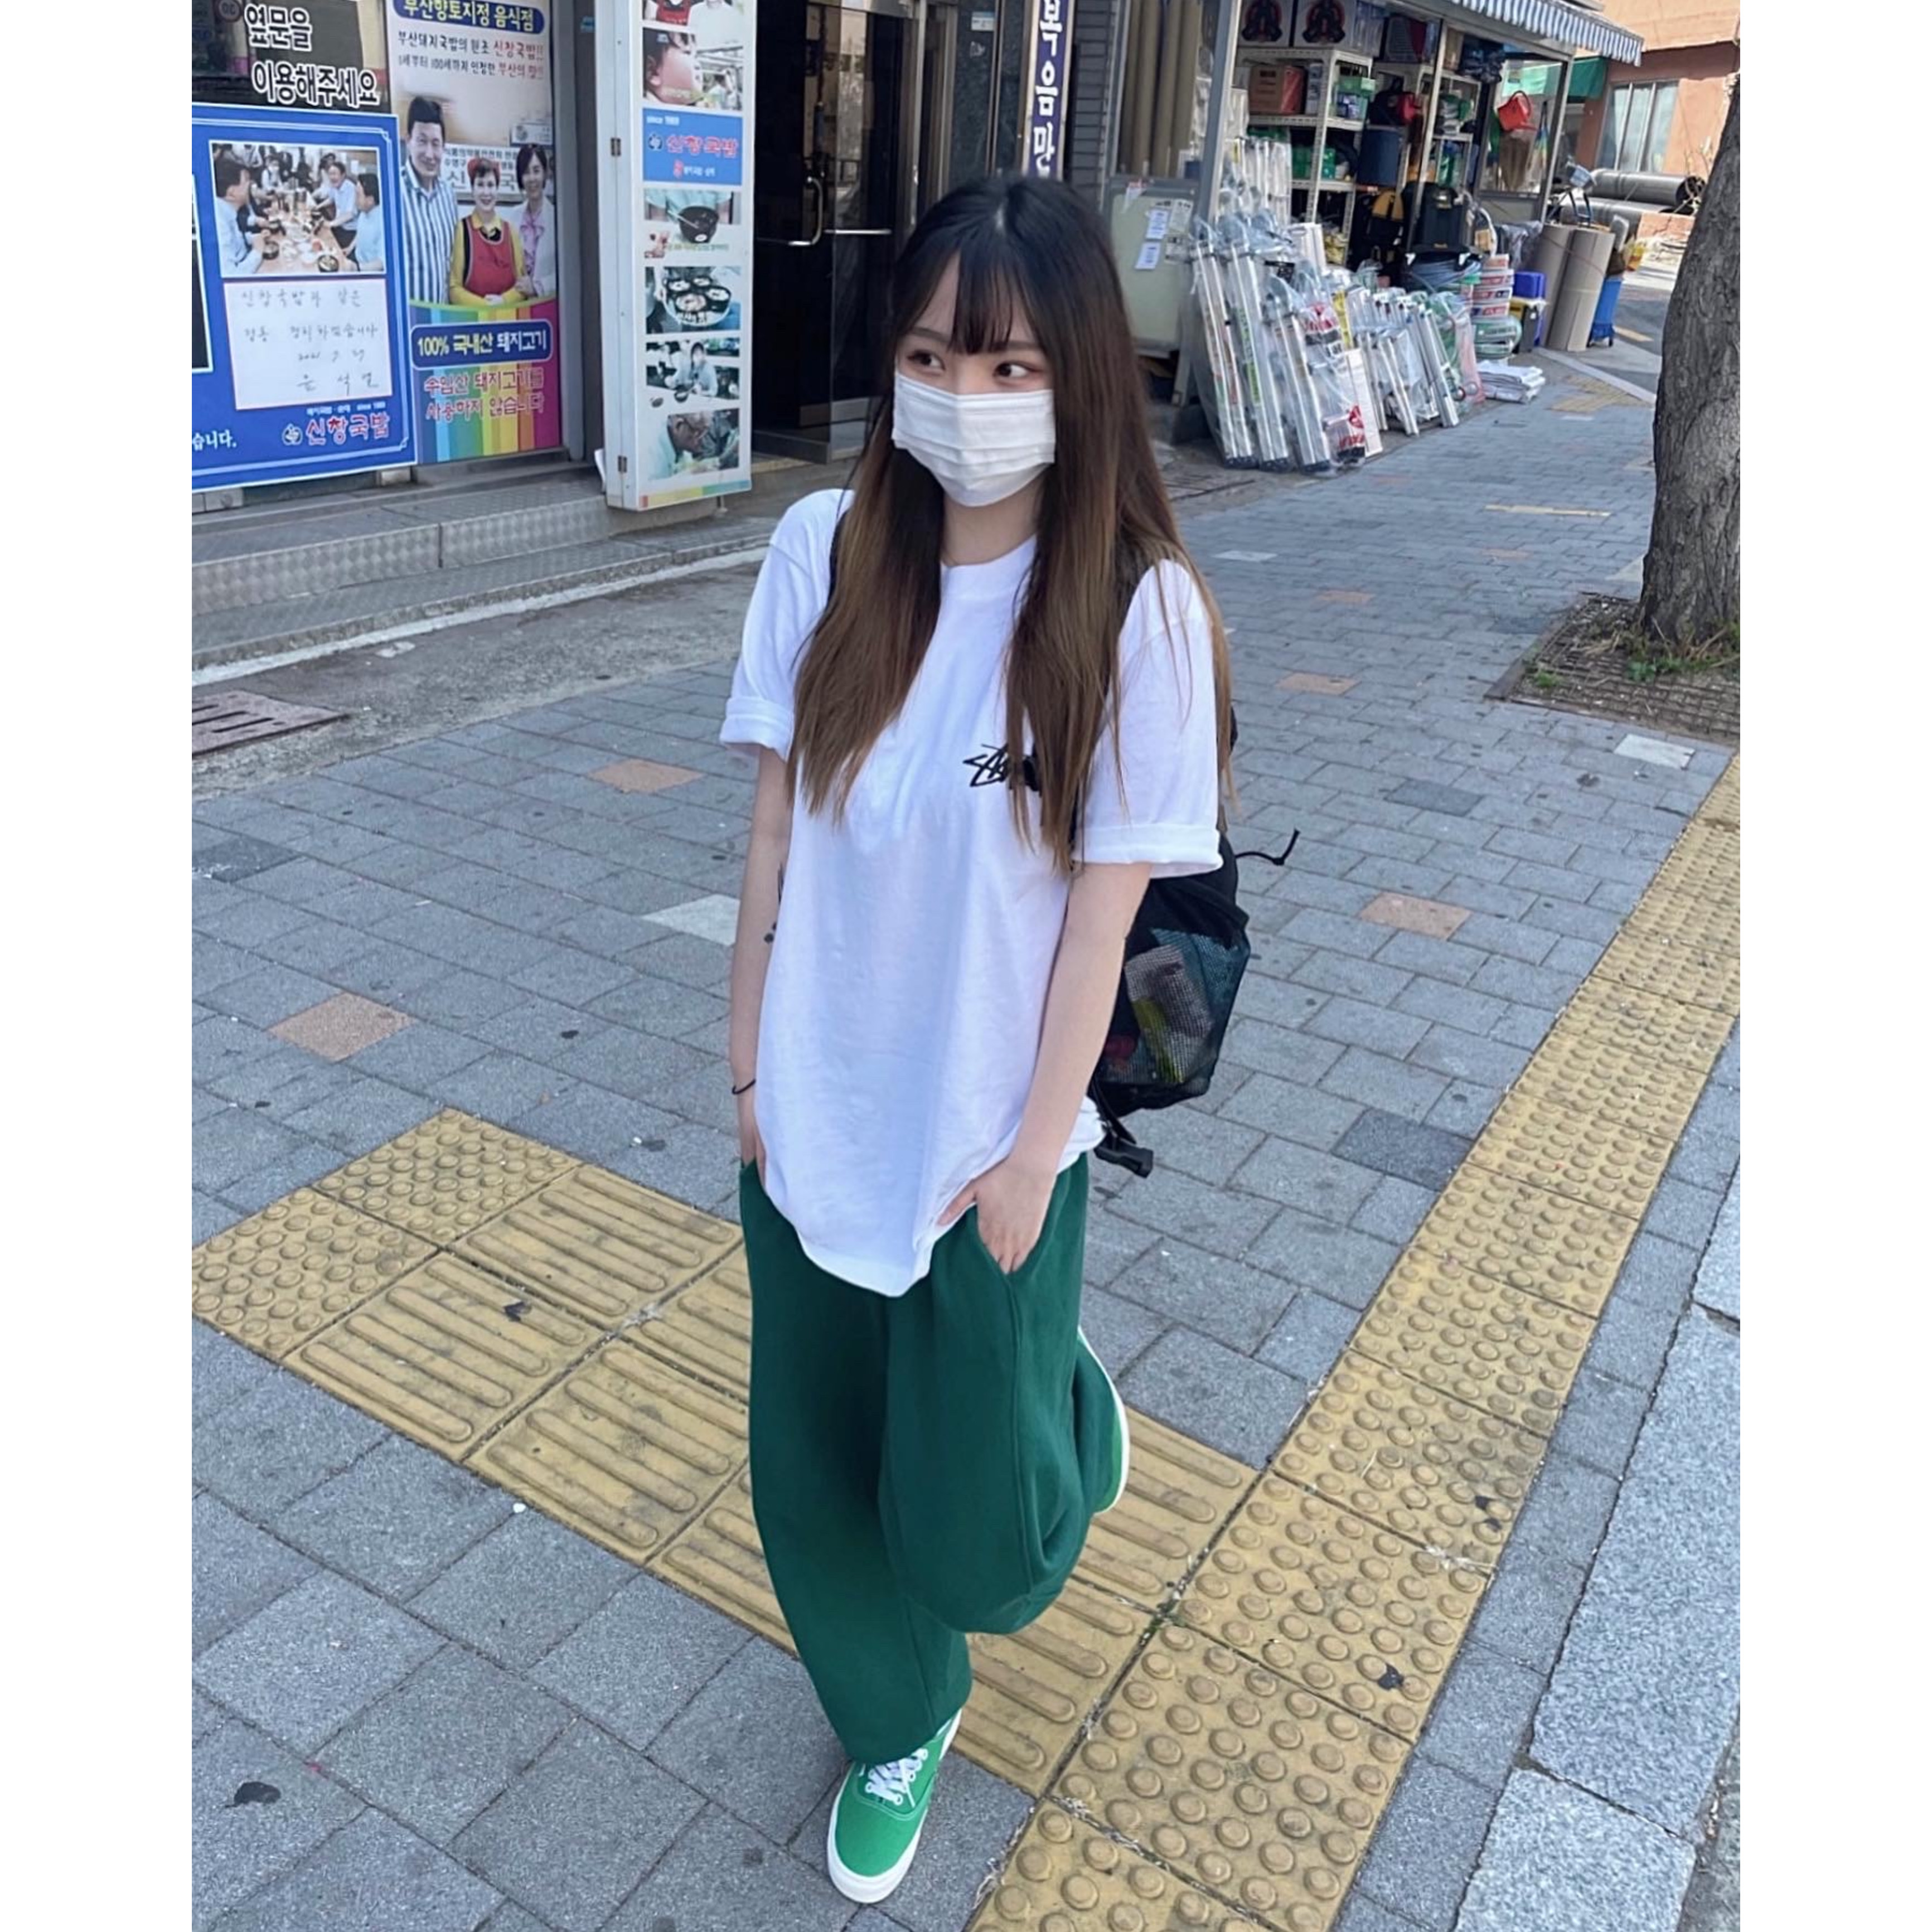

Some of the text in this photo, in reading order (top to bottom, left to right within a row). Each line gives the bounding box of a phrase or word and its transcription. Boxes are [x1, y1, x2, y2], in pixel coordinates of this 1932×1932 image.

[245, 4, 311, 51] 옆문을
[404, 0, 533, 31] 부산향토지정 음식점
[398, 31, 467, 51] 부산돼지국밥의
[471, 39, 489, 54] 원조
[252, 60, 380, 108] 이용해주세요
[417, 330, 547, 357] 100% 국내산 돼지고기
[424, 367, 544, 398] 수입산 돼지고기를
[426, 391, 545, 423] 사용하지 않습니다
[192, 429, 237, 452] 습니다.
[306, 411, 390, 446] 신창국밥
